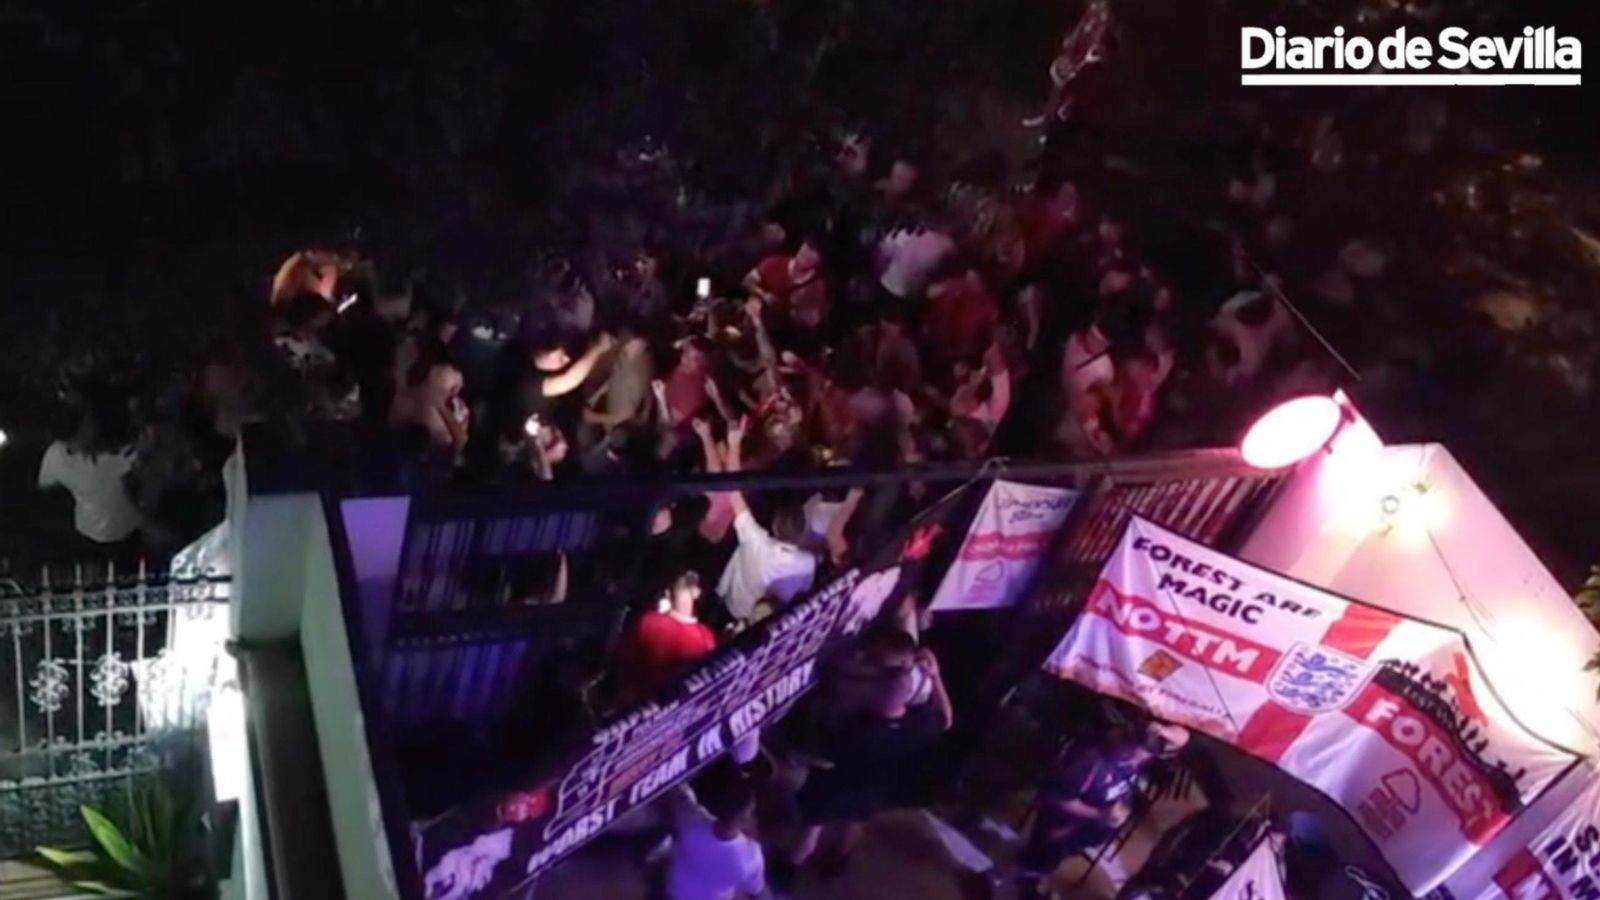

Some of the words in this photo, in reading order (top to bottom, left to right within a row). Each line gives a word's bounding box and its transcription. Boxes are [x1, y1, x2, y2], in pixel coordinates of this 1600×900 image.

[1131, 536, 1247, 592] FOREST
[1253, 590, 1324, 619] ARE
[1157, 572, 1264, 625] MAGIC
[1096, 588, 1261, 674] NOTTM
[629, 745, 691, 804] TEAM
[729, 656, 817, 738] HISTORY
[1365, 697, 1493, 829] FOREST
[1543, 835, 1580, 875] IN
